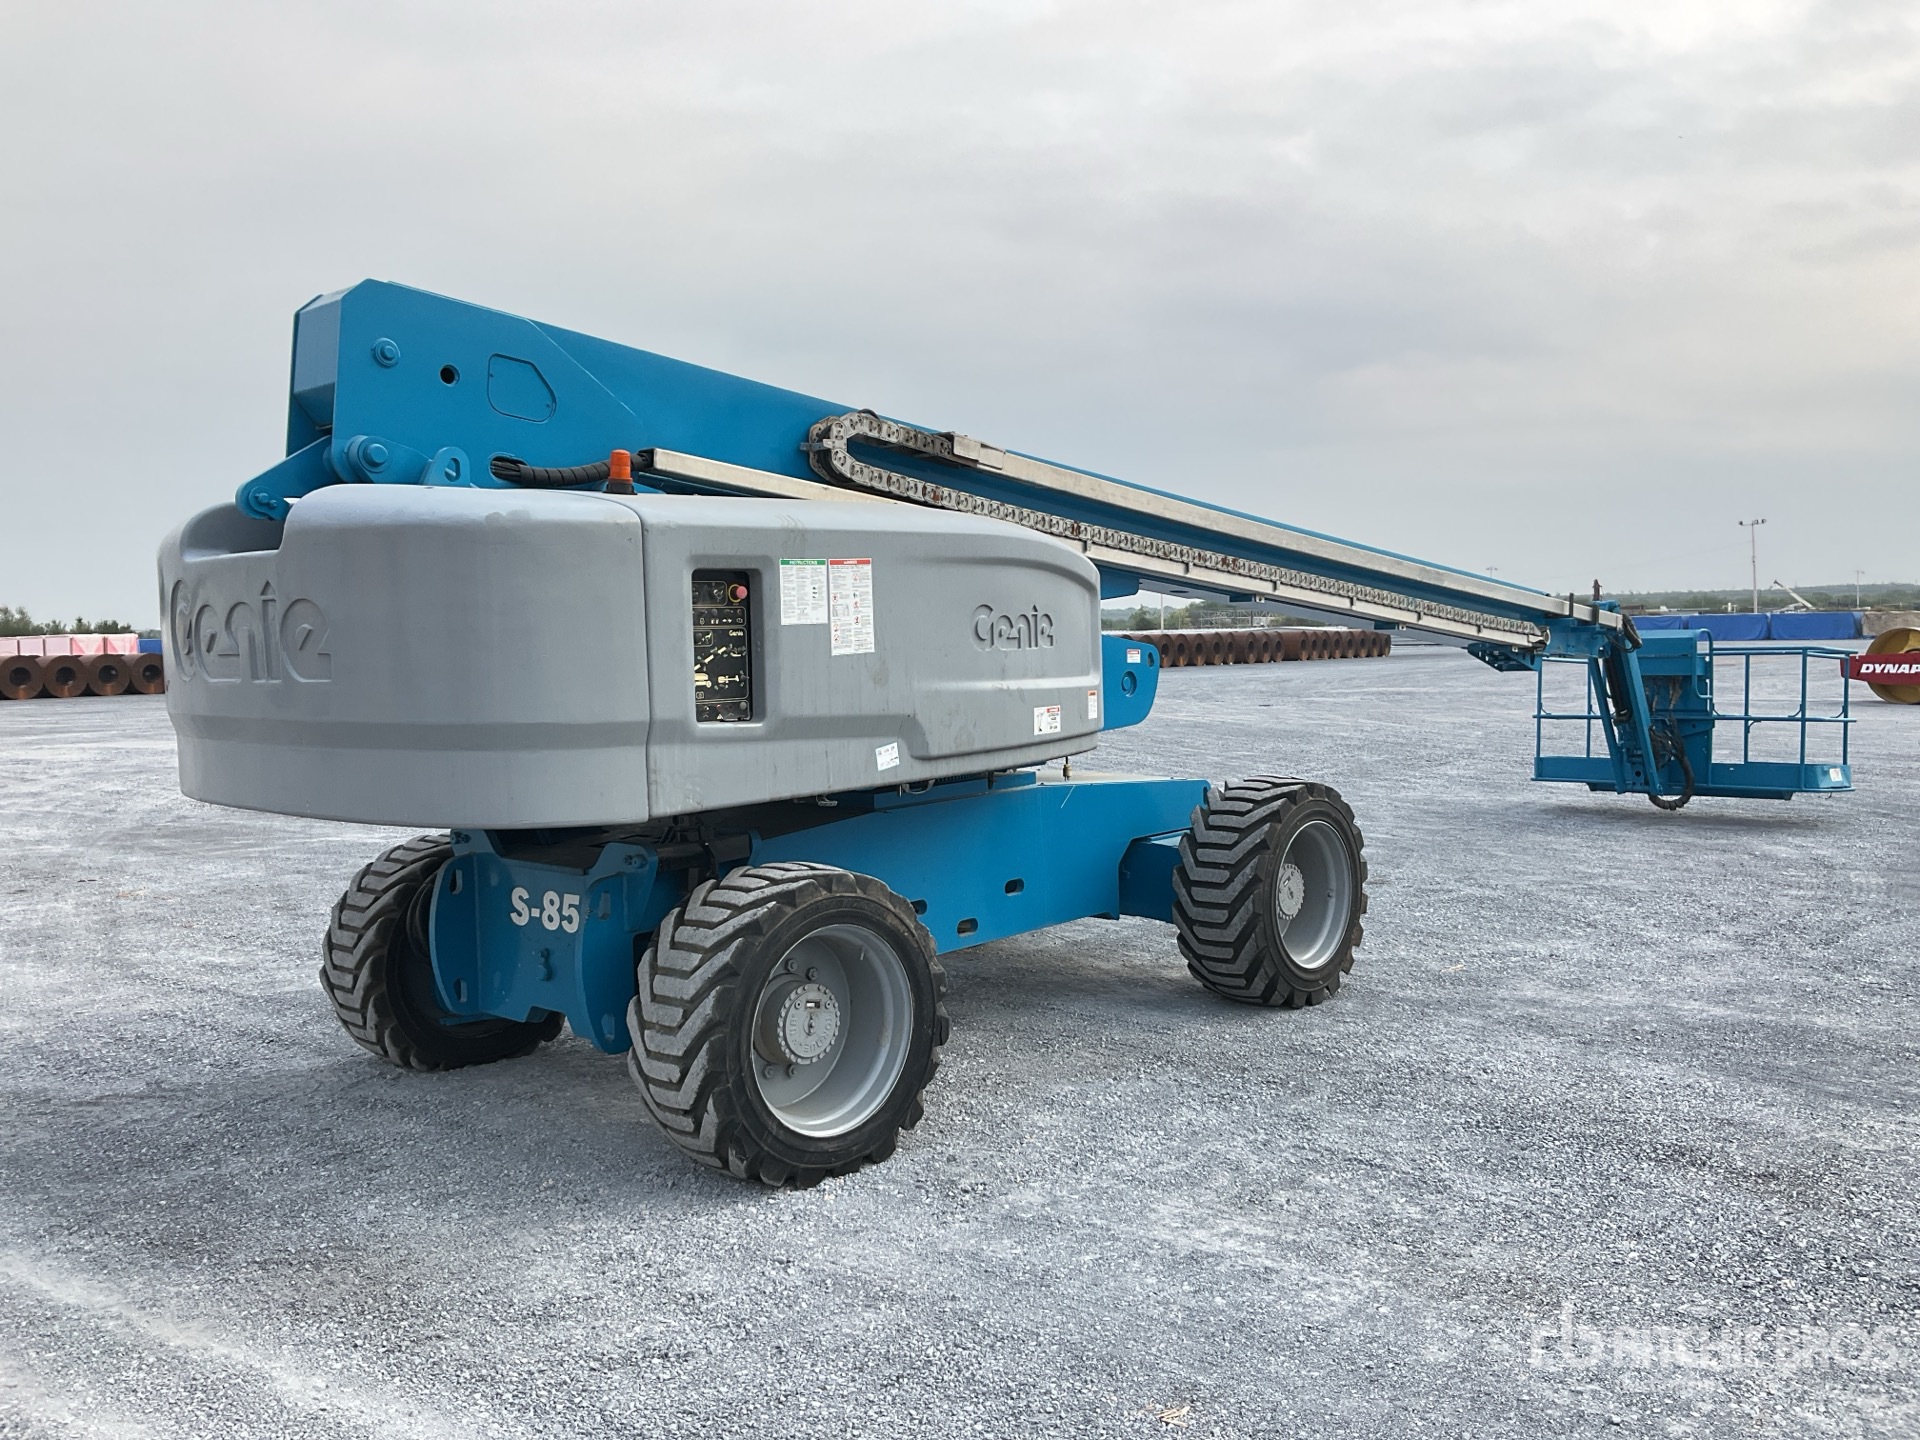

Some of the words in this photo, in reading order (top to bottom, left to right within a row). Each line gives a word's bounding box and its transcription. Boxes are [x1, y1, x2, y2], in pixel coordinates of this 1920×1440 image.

[169, 578, 333, 683] Genie
[970, 604, 1058, 651] Genie
[1860, 663, 1920, 674] DYNAP
[509, 886, 580, 933] S-85
